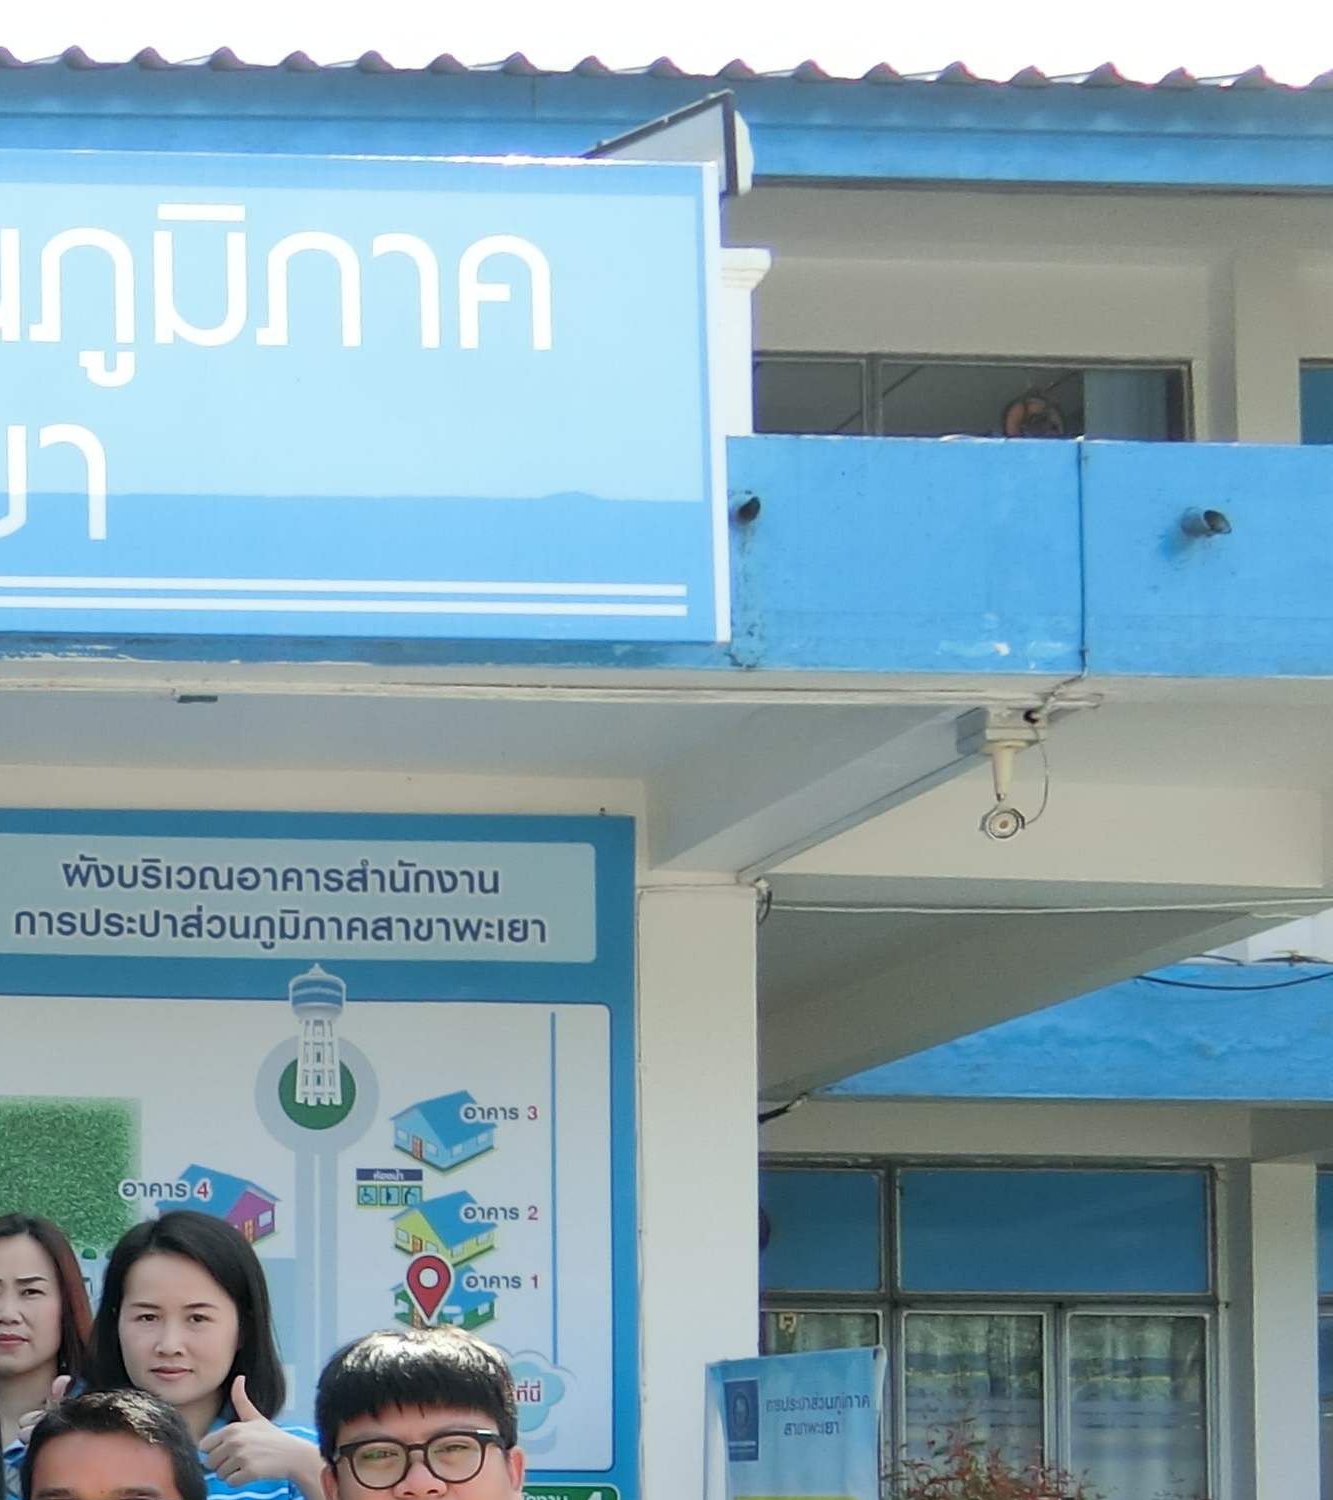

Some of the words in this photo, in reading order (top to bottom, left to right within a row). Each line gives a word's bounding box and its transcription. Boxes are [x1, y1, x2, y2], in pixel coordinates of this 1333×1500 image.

[60, 854, 500, 898] ผังบริเวณอาคารสำนักงาน
[13, 907, 547, 950] การประปาส่วนภูมิภาคสาขาพะเยา
[463, 1105, 520, 1121] อาคาร
[526, 1105, 539, 1121] 3
[121, 1181, 188, 1198] อาคาร
[196, 1180, 209, 1199] 4
[463, 1205, 520, 1222] อาคาร
[527, 1204, 539, 1221] 2
[465, 1274, 522, 1290] อาคาร
[530, 1274, 539, 1290] 1
